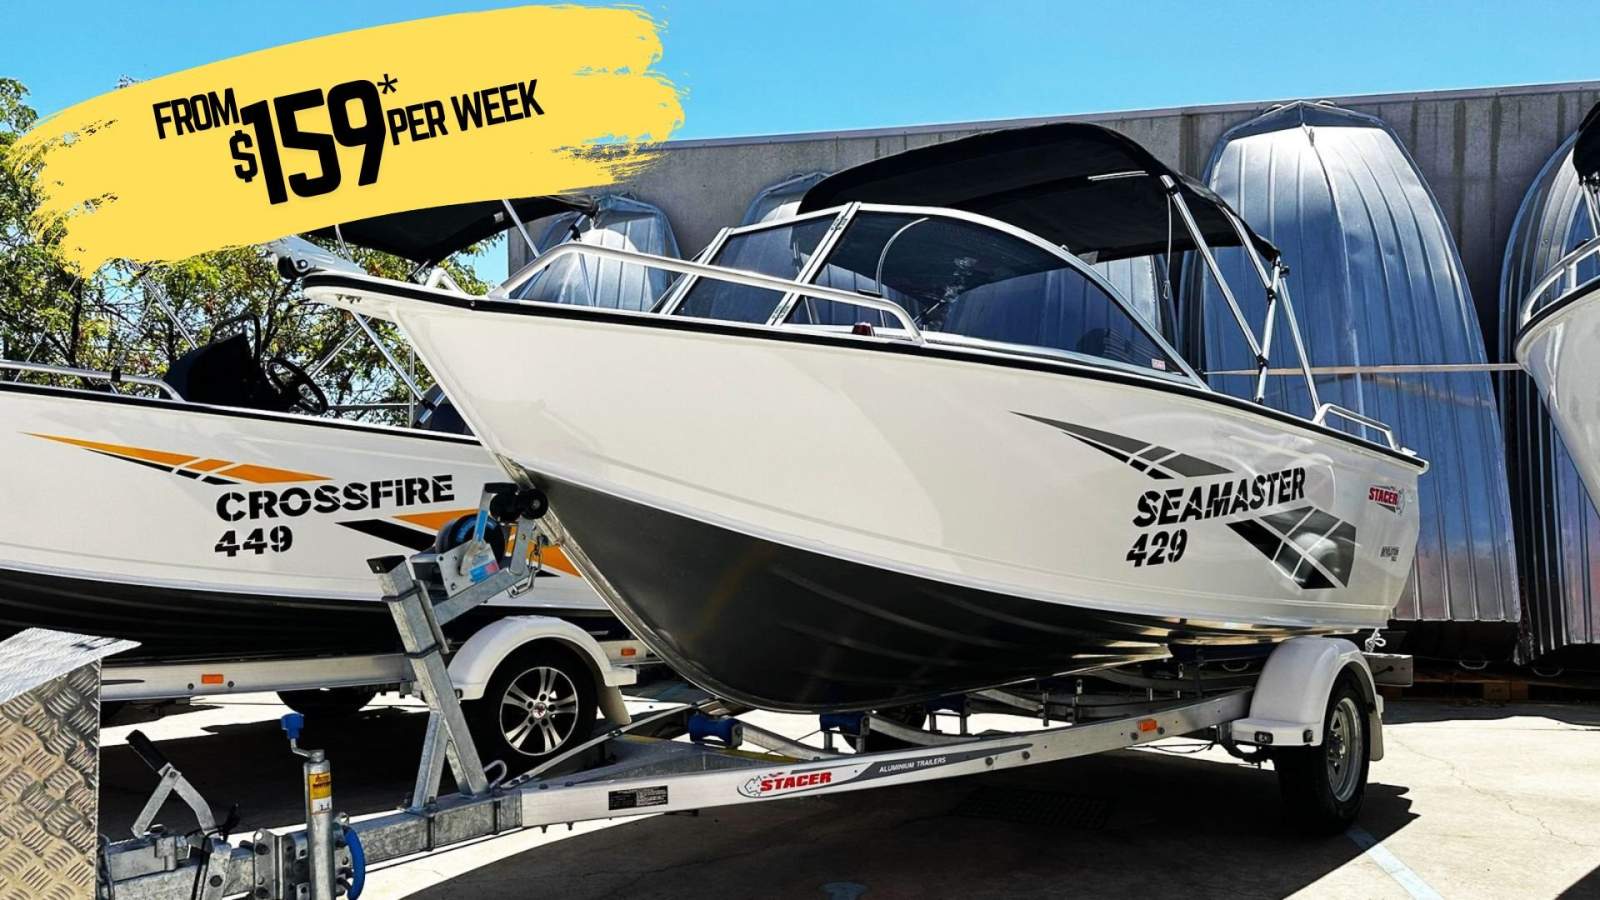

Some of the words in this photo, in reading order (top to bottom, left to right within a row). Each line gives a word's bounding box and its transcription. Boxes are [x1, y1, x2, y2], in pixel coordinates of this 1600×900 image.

[216, 475, 455, 522] CROSSFIRE
[1133, 467, 1306, 527] SEAMASTER
[1369, 488, 1398, 506] STACER
[214, 525, 293, 557] 449
[1126, 529, 1188, 567] 429
[760, 772, 832, 791] STACER
[879, 761, 915, 773] ALUMINIUM
[917, 757, 946, 768] TRAILERS
